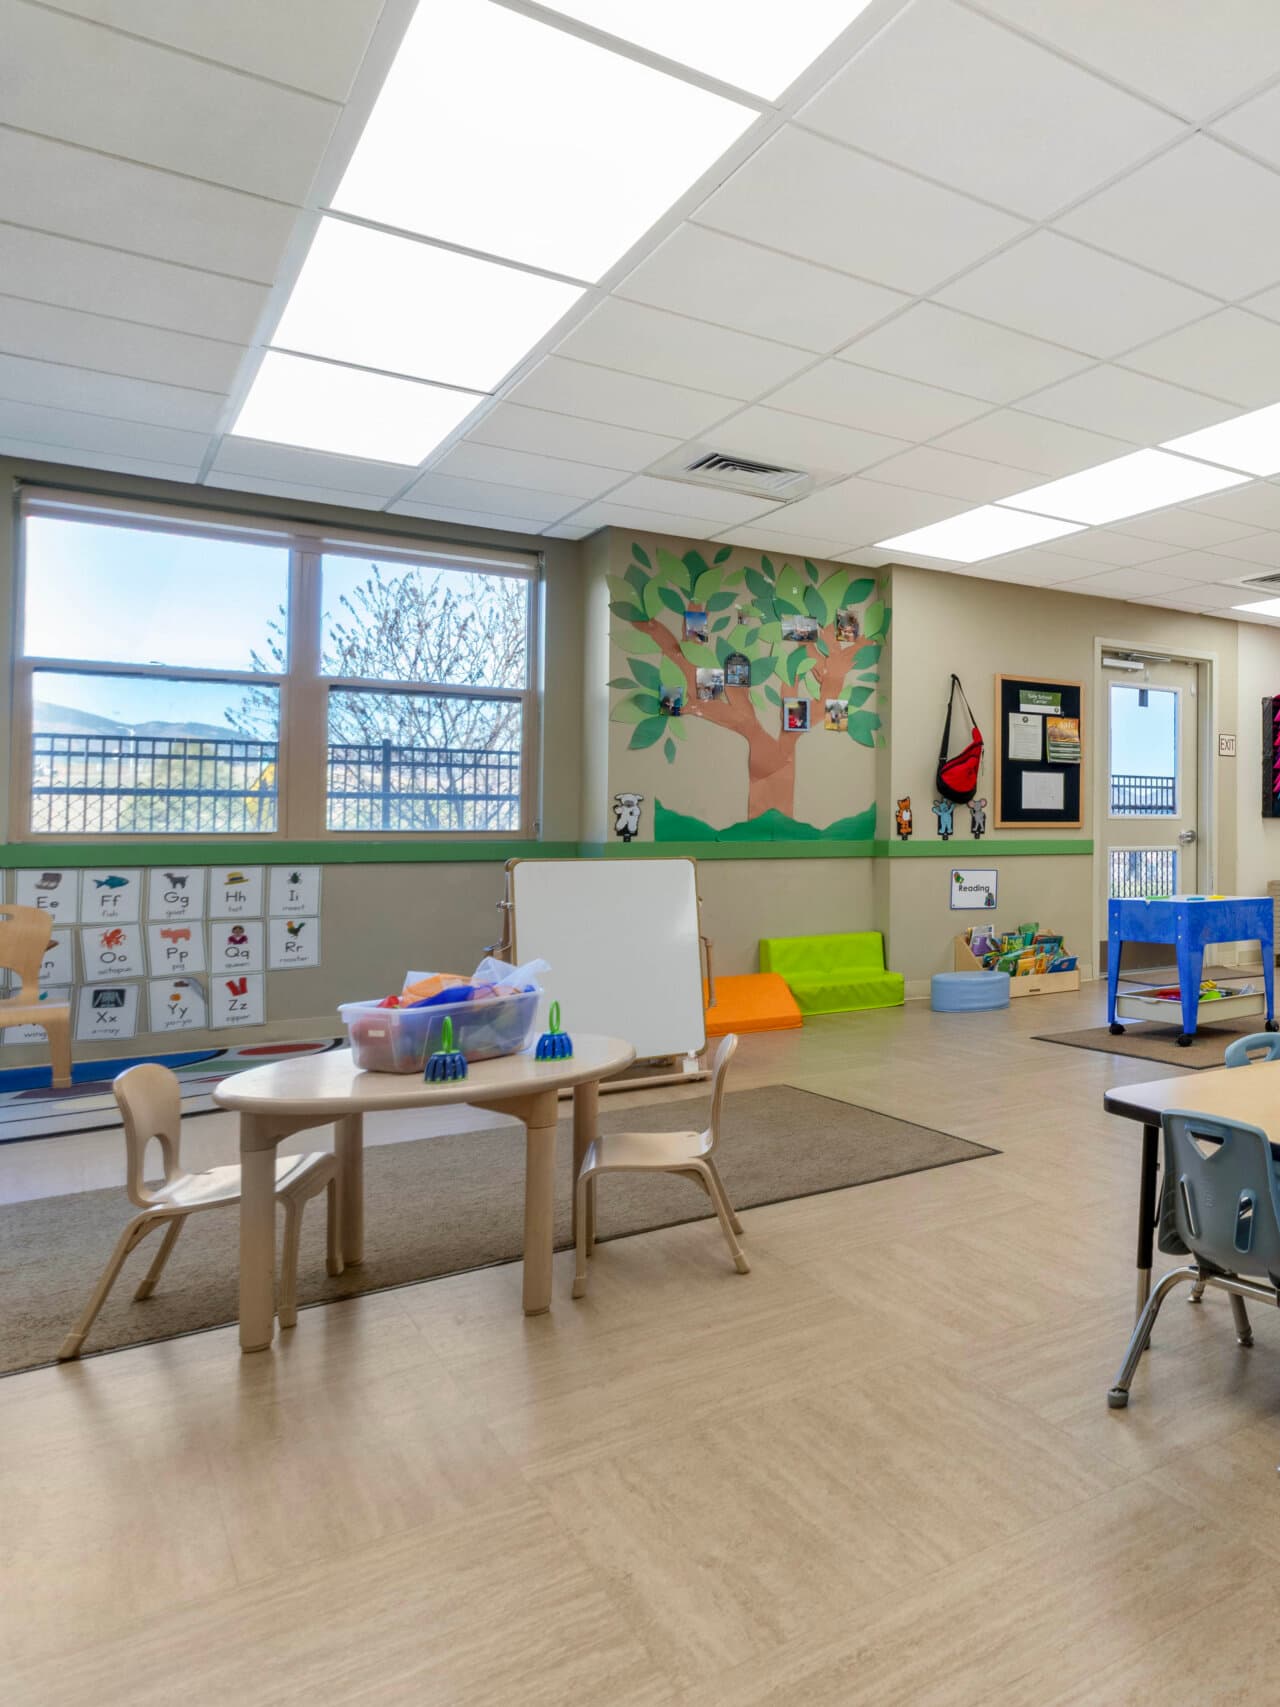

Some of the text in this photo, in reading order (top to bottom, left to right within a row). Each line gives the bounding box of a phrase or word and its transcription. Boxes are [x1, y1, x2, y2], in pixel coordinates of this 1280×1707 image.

[1221, 738, 1235, 751] EXIT
[958, 884, 991, 894] Reading
[36, 896, 60, 909] Ee
[101, 895, 121, 907] Ff
[164, 891, 190, 908] Gg
[225, 891, 247, 902] Hh
[225, 946, 250, 960] Qq
[285, 941, 304, 953] Rr
[100, 951, 128, 964] Oo
[167, 947, 189, 963] Pp
[167, 1003, 189, 1019] Yy
[228, 999, 248, 1011] Zz
[96, 1011, 118, 1023] Xx
